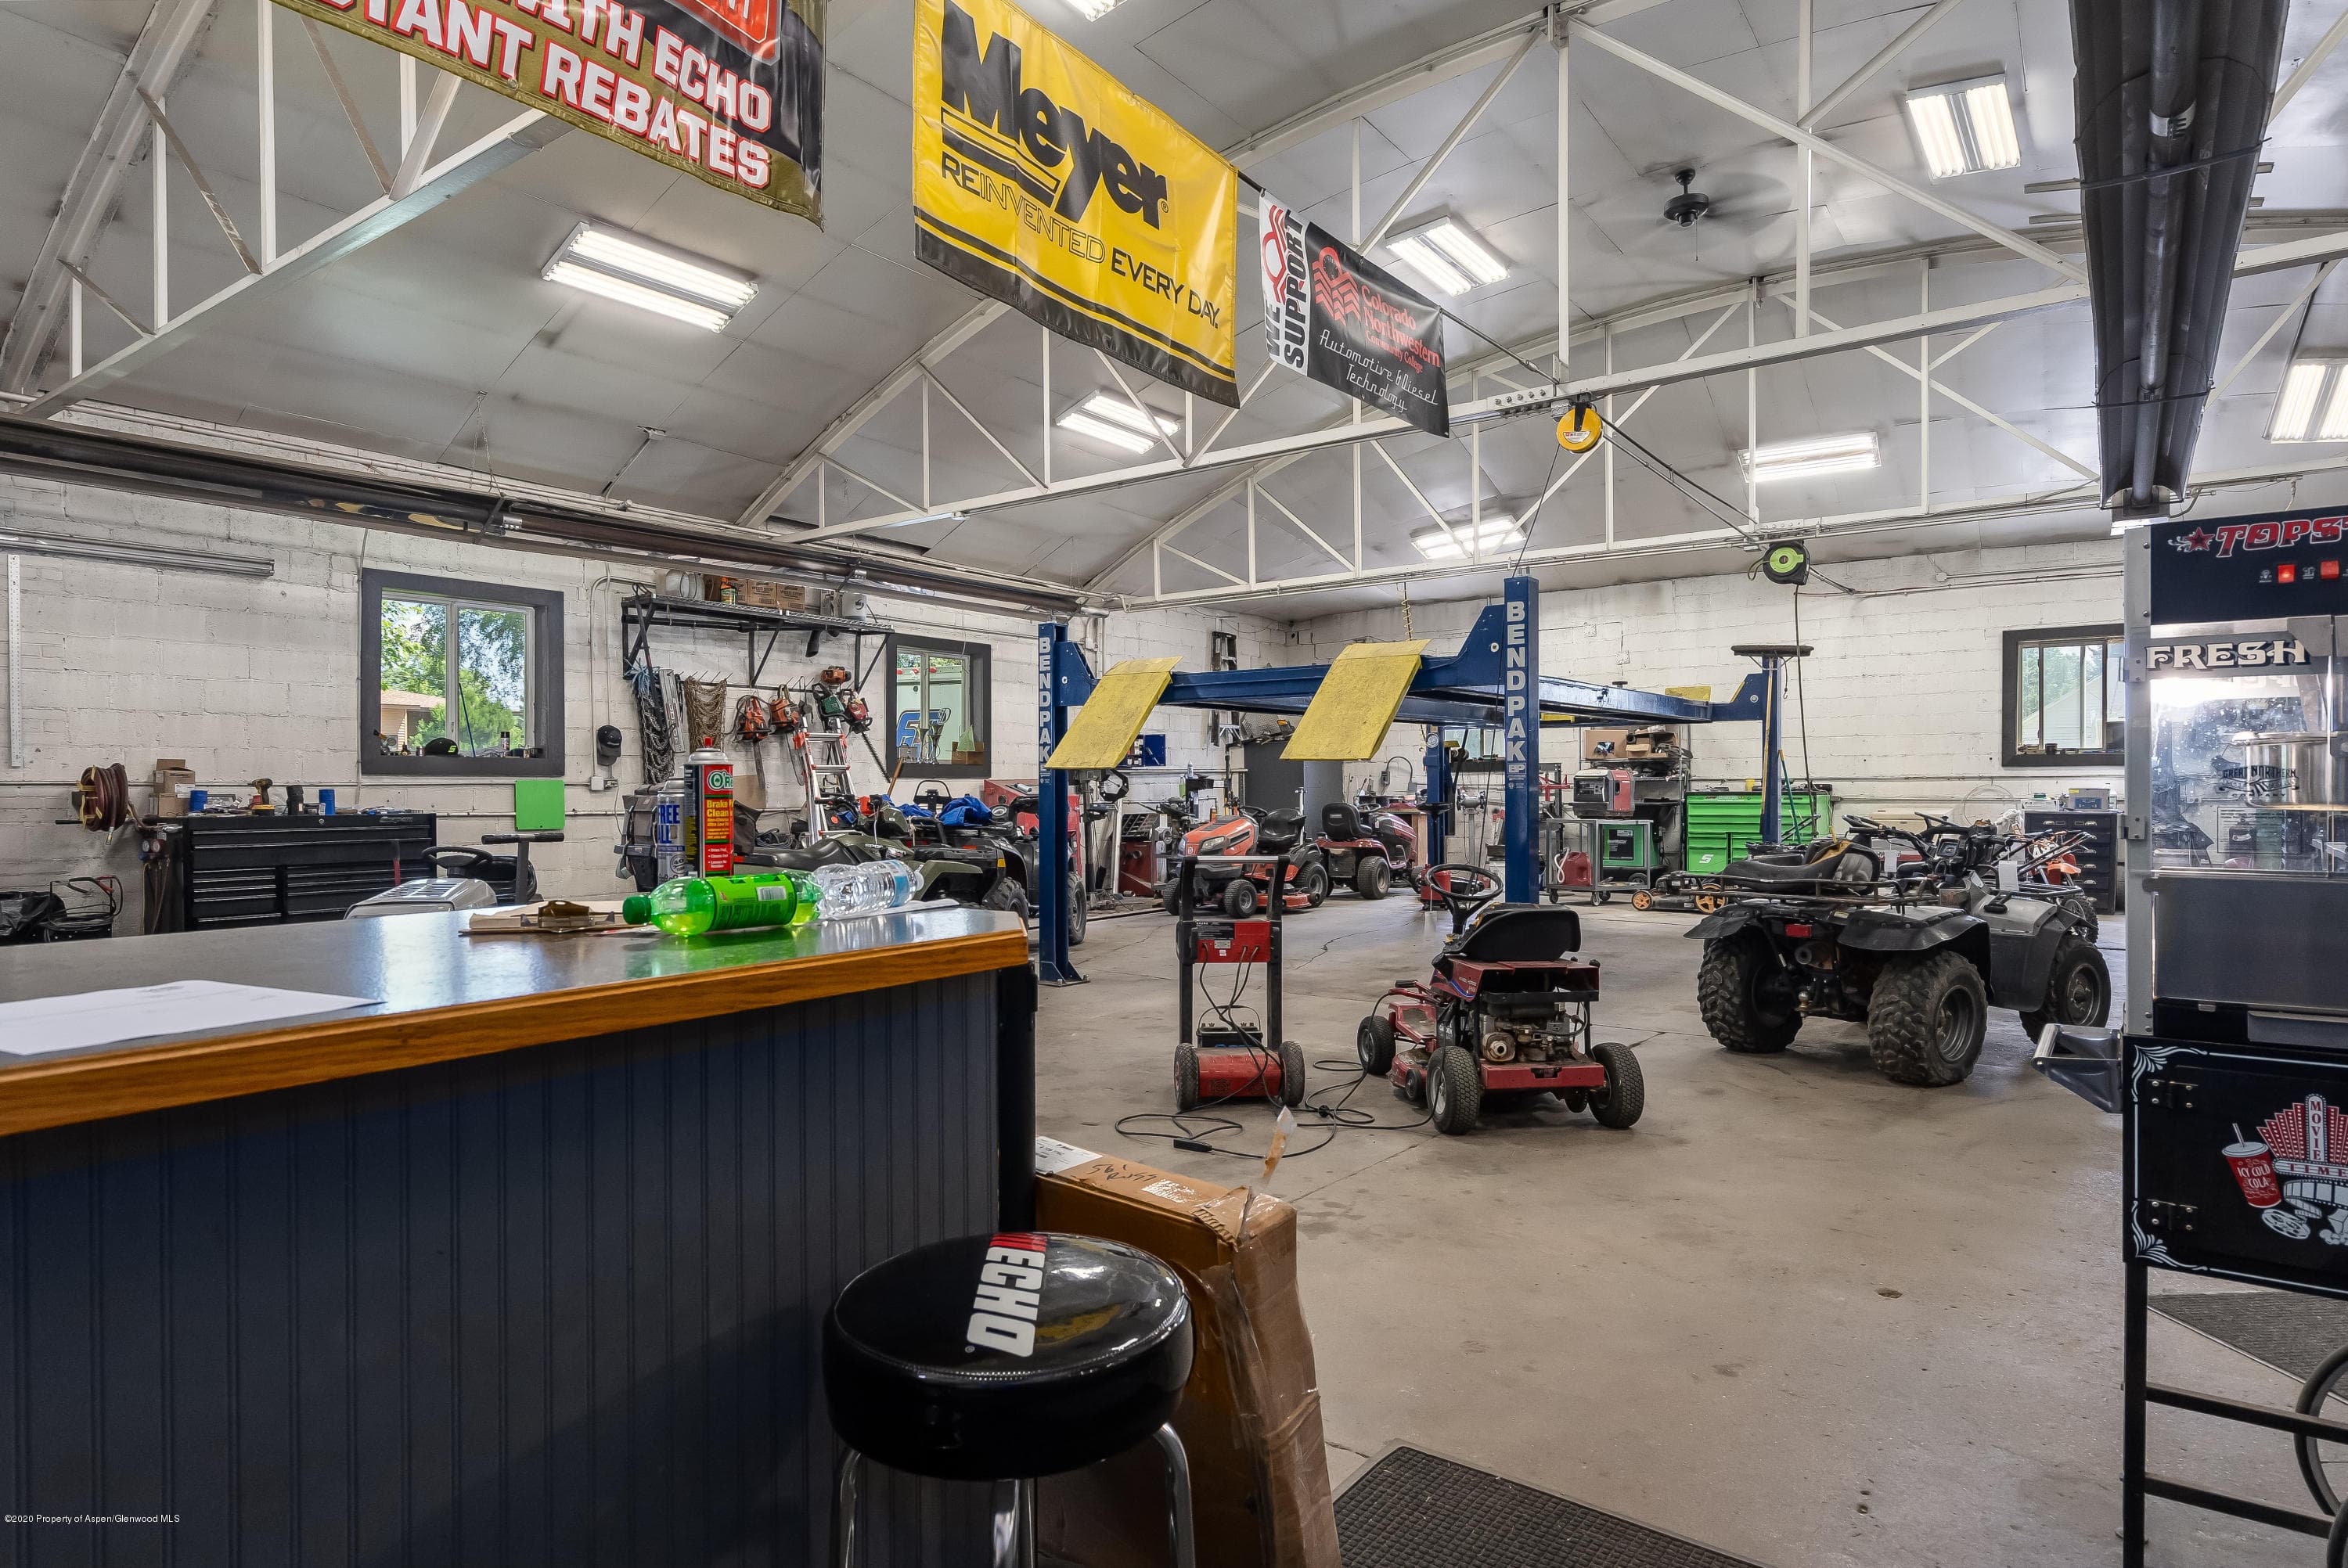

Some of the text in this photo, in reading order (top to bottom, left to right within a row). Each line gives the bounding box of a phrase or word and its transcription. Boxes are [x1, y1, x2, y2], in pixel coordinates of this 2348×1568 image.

[652, 25, 772, 133] ECHO
[539, 38, 771, 189] REBATES
[942, 1, 1168, 230] Meyer
[942, 150, 1106, 264] REINVENTED
[1111, 247, 1185, 304] EVERY
[1284, 209, 1306, 369] SUPPORT
[1361, 285, 1417, 331] Colorado
[1320, 329, 1394, 383] Automotive
[1364, 307, 1440, 368] Northwestern
[1365, 330, 1405, 362] Community
[1404, 354, 1424, 374] College
[1346, 362, 1407, 412] Technology
[1507, 601, 1525, 761] BENDPAK
[2145, 640, 2307, 671] FRESH
[1039, 637, 1051, 762] BENDPAK
[2223, 764, 2296, 779] GREAT NORTHERN
[707, 799, 728, 808] Brake
[2310, 1100, 2321, 1160] MOVIE
[2237, 1163, 2270, 1178] ICY COLD
[2248, 1177, 2269, 1189] COLA
[2289, 1163, 2347, 1178] TIME
[966, 1246, 1046, 1358] ECHO
